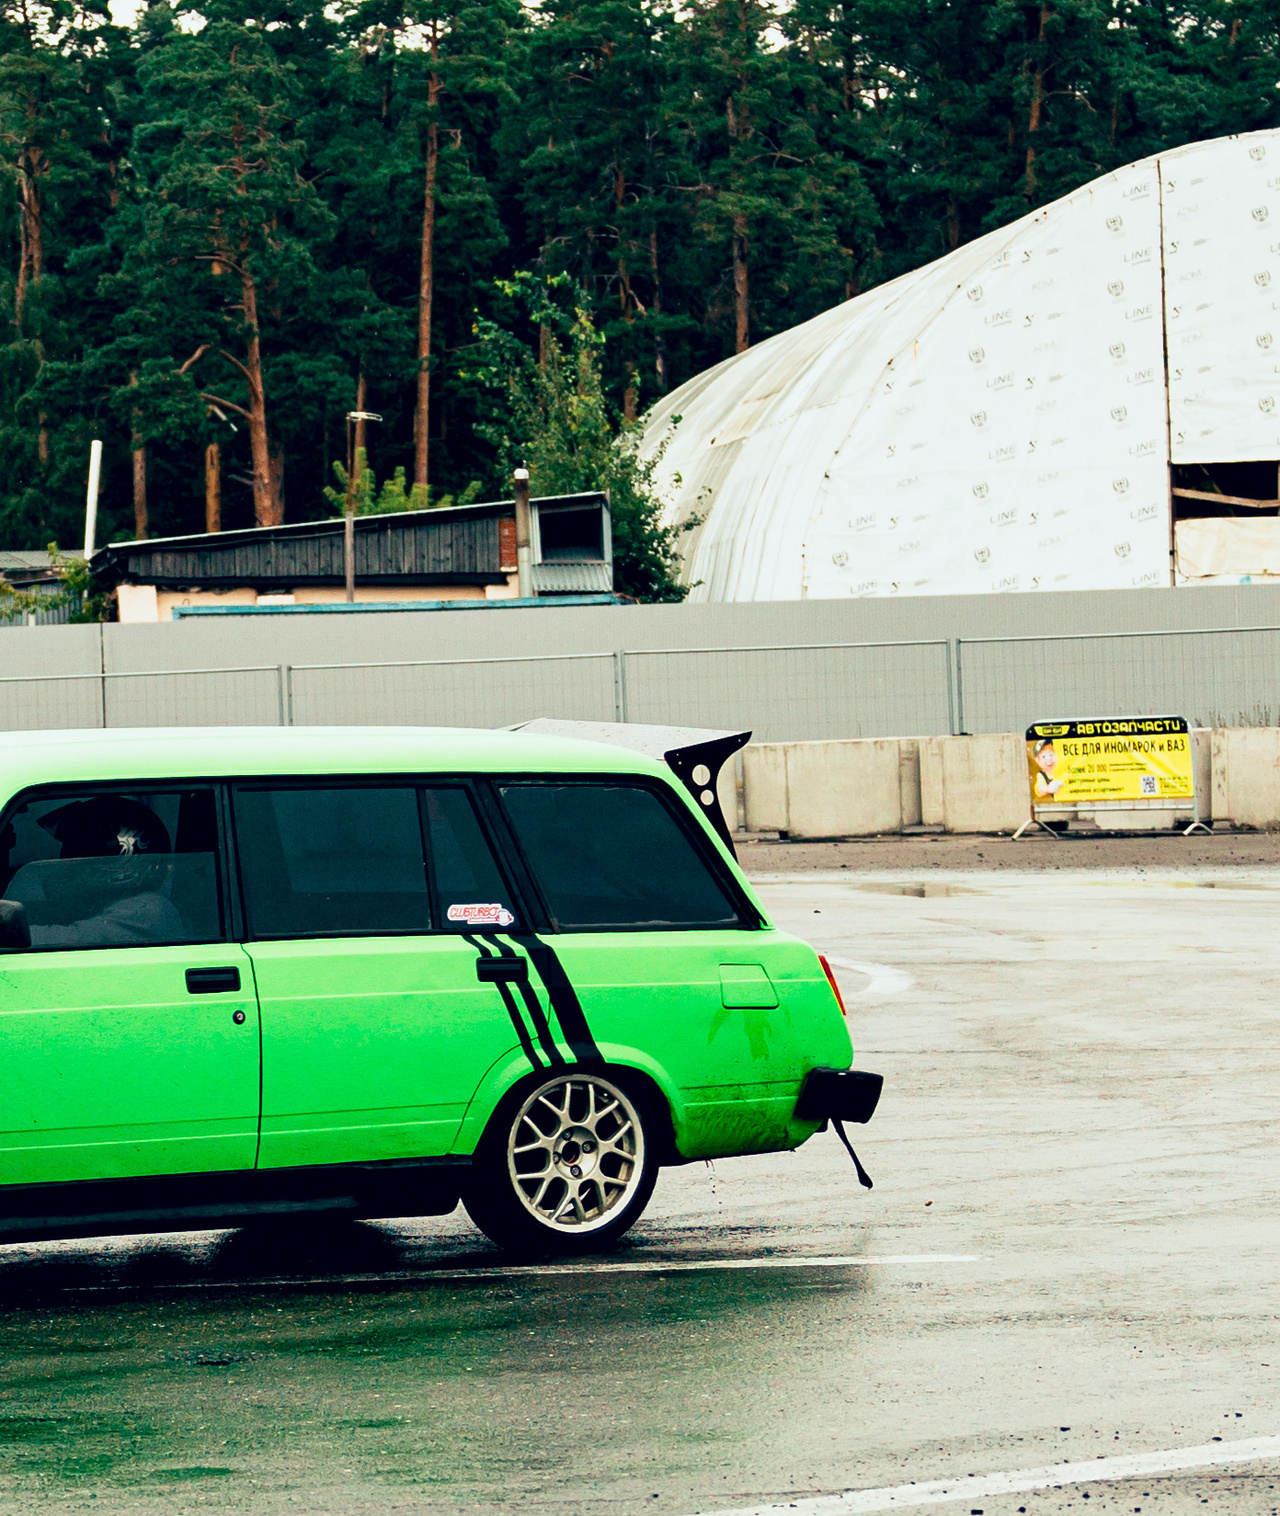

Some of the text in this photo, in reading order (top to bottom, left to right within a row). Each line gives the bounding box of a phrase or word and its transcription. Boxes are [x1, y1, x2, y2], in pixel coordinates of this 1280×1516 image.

[1122, 182, 1150, 198] LINE
[1123, 246, 1152, 262] LINE
[984, 308, 1013, 324] LINE
[1125, 304, 1153, 320] LINE
[986, 371, 1015, 388] LINE
[1126, 367, 1155, 384] LINE
[988, 443, 1017, 460] LINE
[1128, 439, 1157, 455] LINE
[990, 508, 1018, 525] LINE
[1130, 503, 1159, 519] LINE
[848, 513, 876, 528] LINE
[991, 575, 1020, 591] LINE
[1132, 569, 1160, 585] LINE
[850, 579, 878, 594] LINE
[1077, 720, 1180, 735] АВТОЗАПЧАСТИ
[1063, 743, 1079, 756] ВСЕ
[1082, 742, 1101, 757] ДЛЯ
[1104, 740, 1156, 754] ИНОМАРОК
[1167, 738, 1185, 752] ВАЗ
